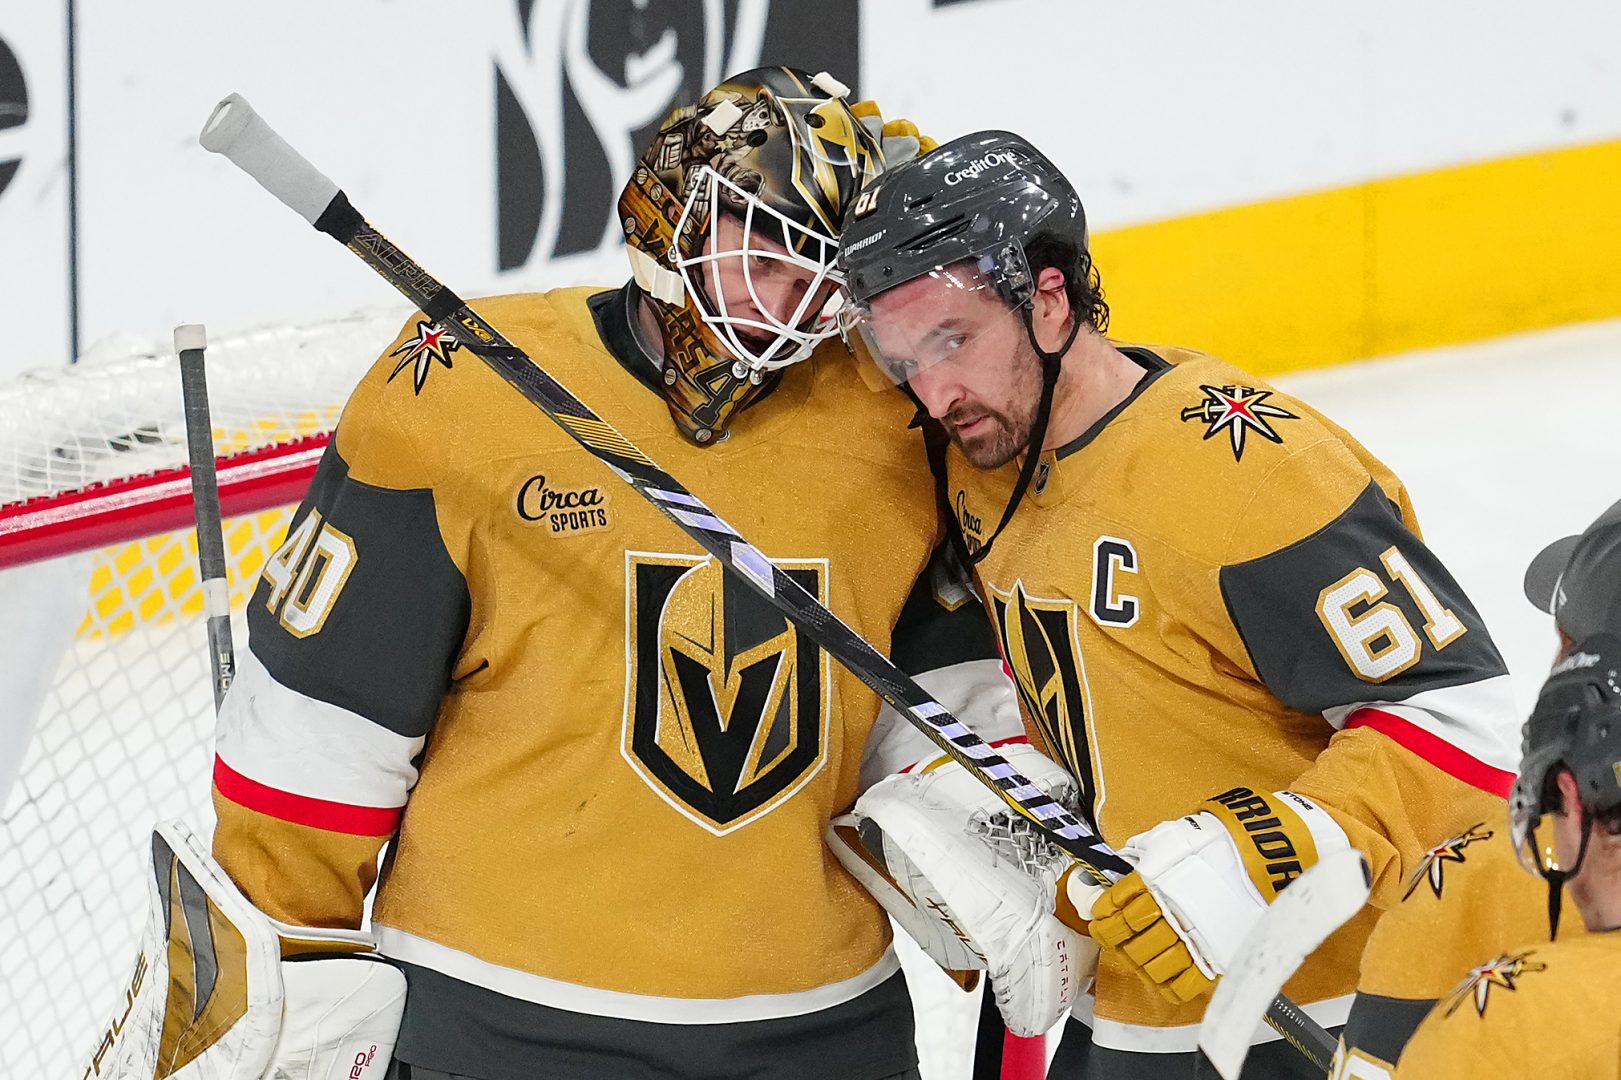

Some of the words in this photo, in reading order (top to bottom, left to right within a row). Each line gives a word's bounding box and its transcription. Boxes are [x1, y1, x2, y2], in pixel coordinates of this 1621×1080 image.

[354, 233, 444, 300] ALPH
[516, 474, 604, 521] Circa
[549, 509, 607, 533] SPORTS
[262, 506, 359, 639] 40
[1090, 535, 1140, 627] C
[1315, 545, 1467, 683] 61
